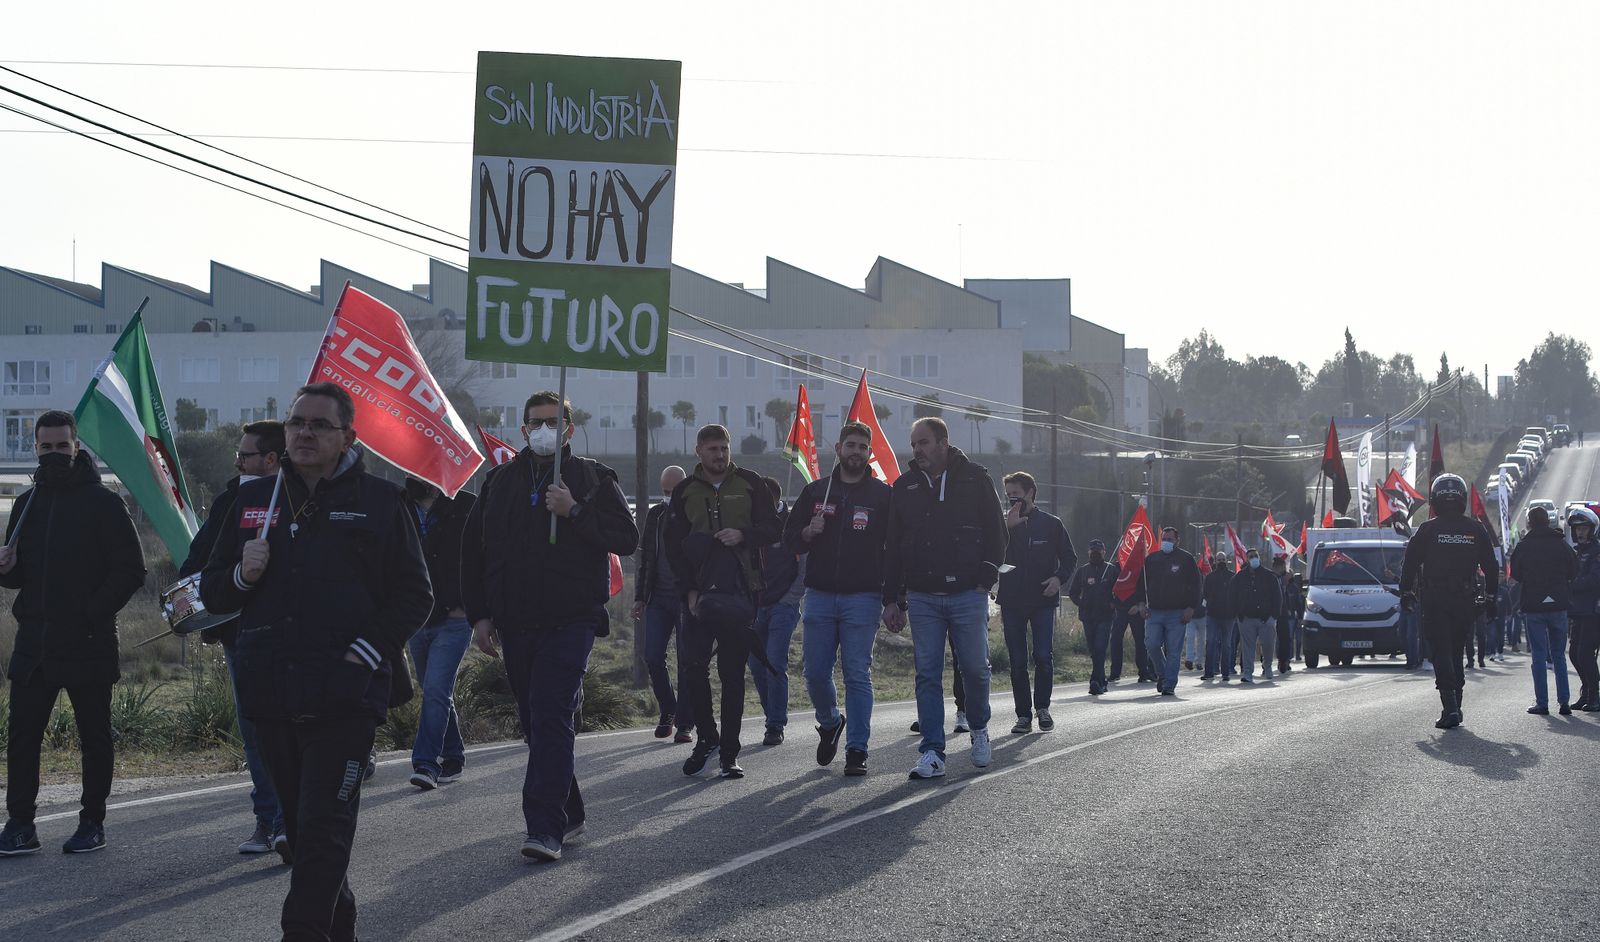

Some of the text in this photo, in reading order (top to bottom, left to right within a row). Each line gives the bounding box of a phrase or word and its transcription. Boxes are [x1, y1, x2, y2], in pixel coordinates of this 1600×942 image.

[479, 159, 672, 264] NO HAY
[322, 365, 463, 466] andalucia.ccoo.es
